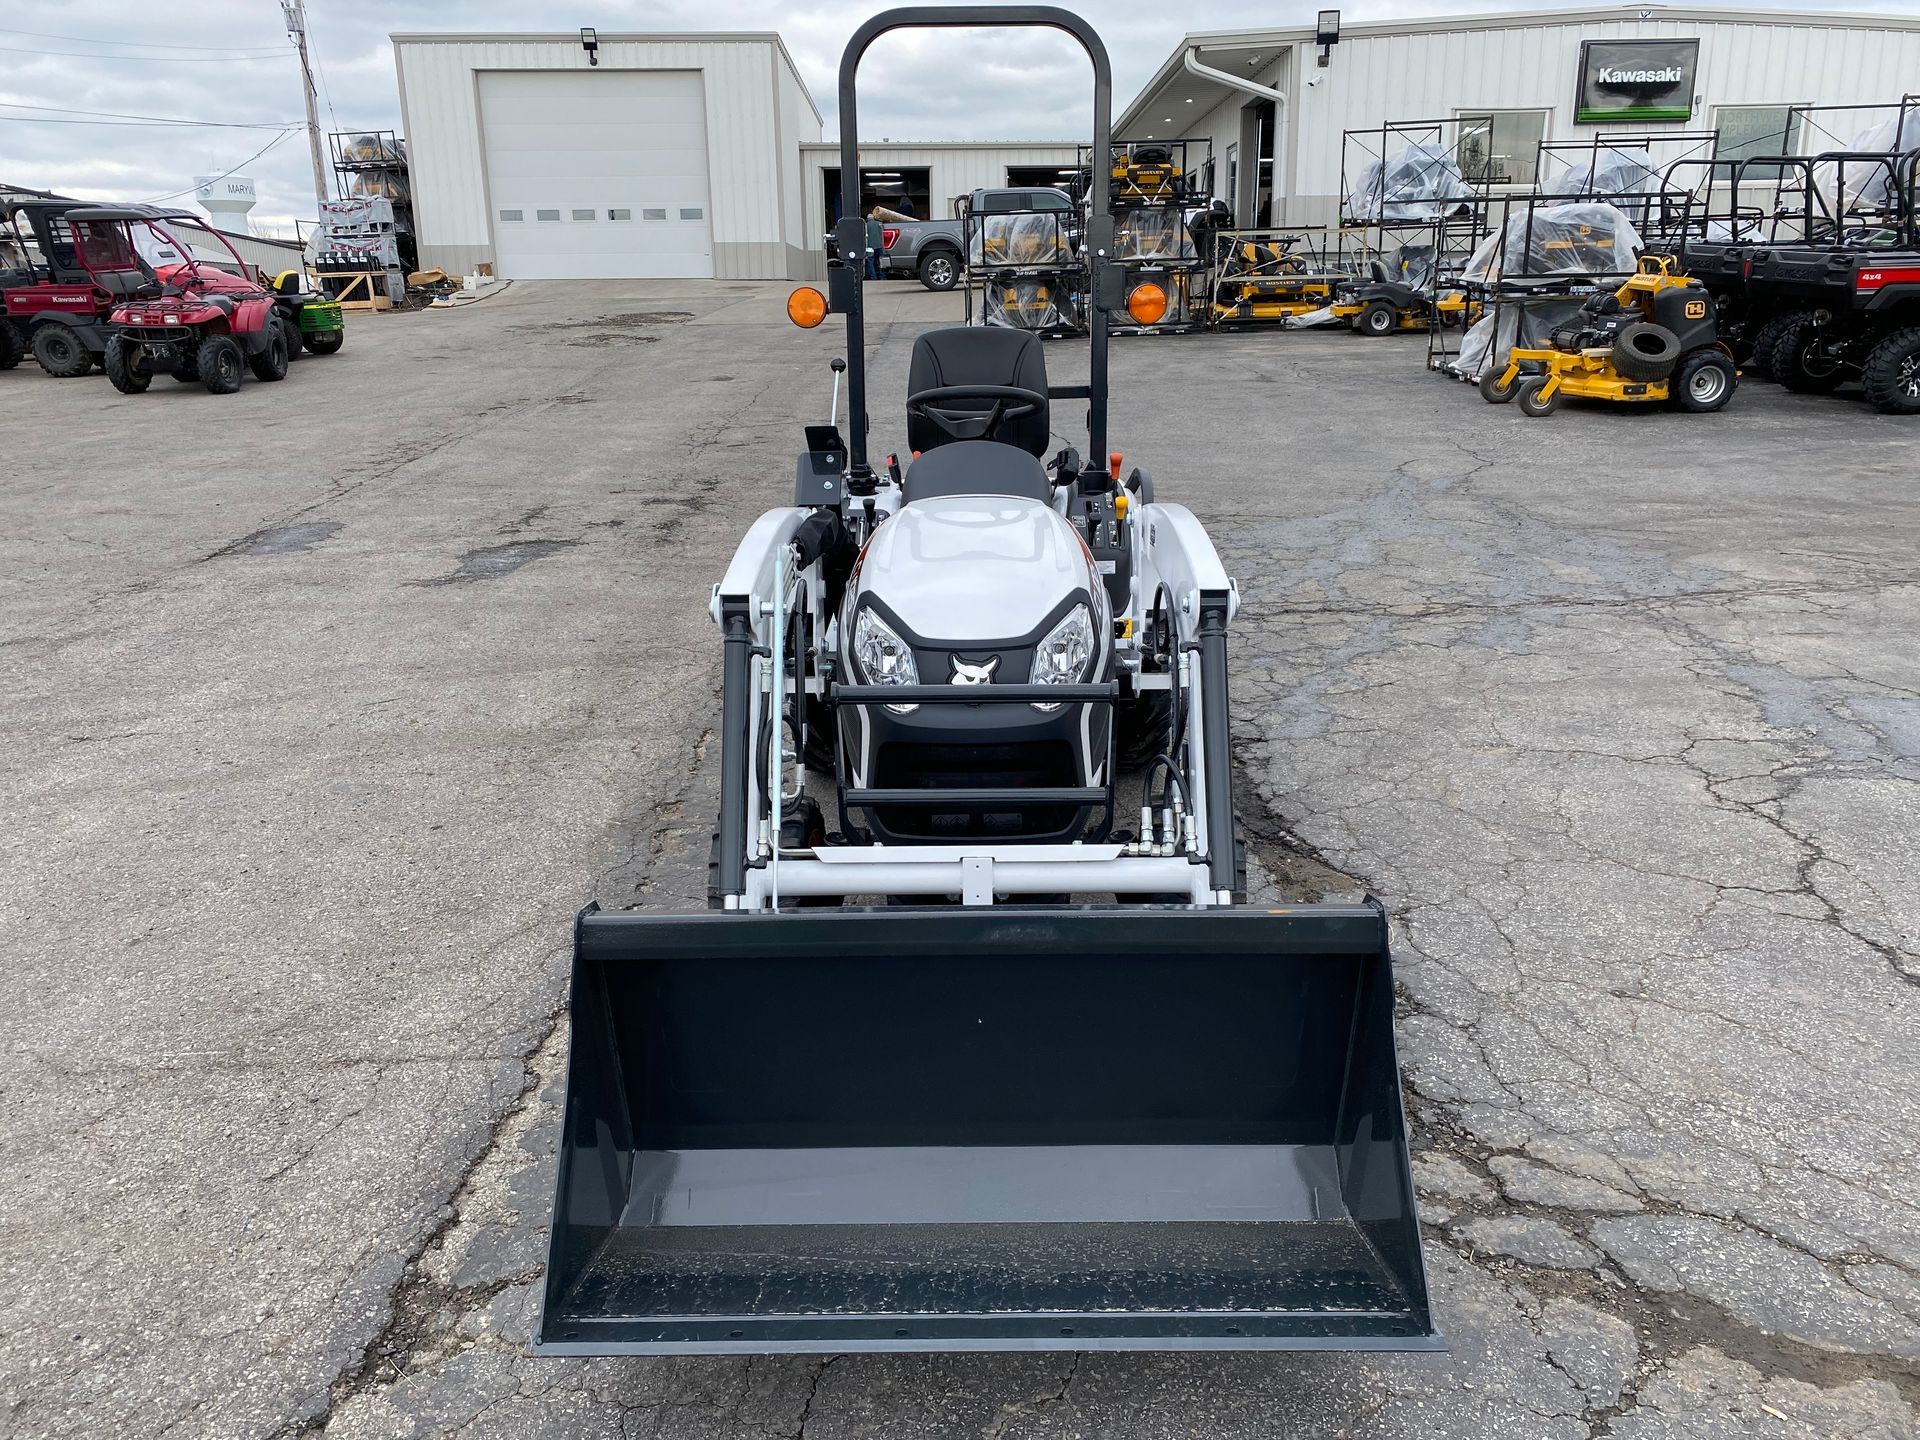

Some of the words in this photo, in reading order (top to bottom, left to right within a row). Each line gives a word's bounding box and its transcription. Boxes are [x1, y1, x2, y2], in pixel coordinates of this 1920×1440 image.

[1598, 66, 1682, 83] Kawasaki
[1718, 111, 1787, 123] NORTHWES
[1718, 124, 1786, 136] MPLEMENT
[52, 295, 87, 303] Kawasaki
